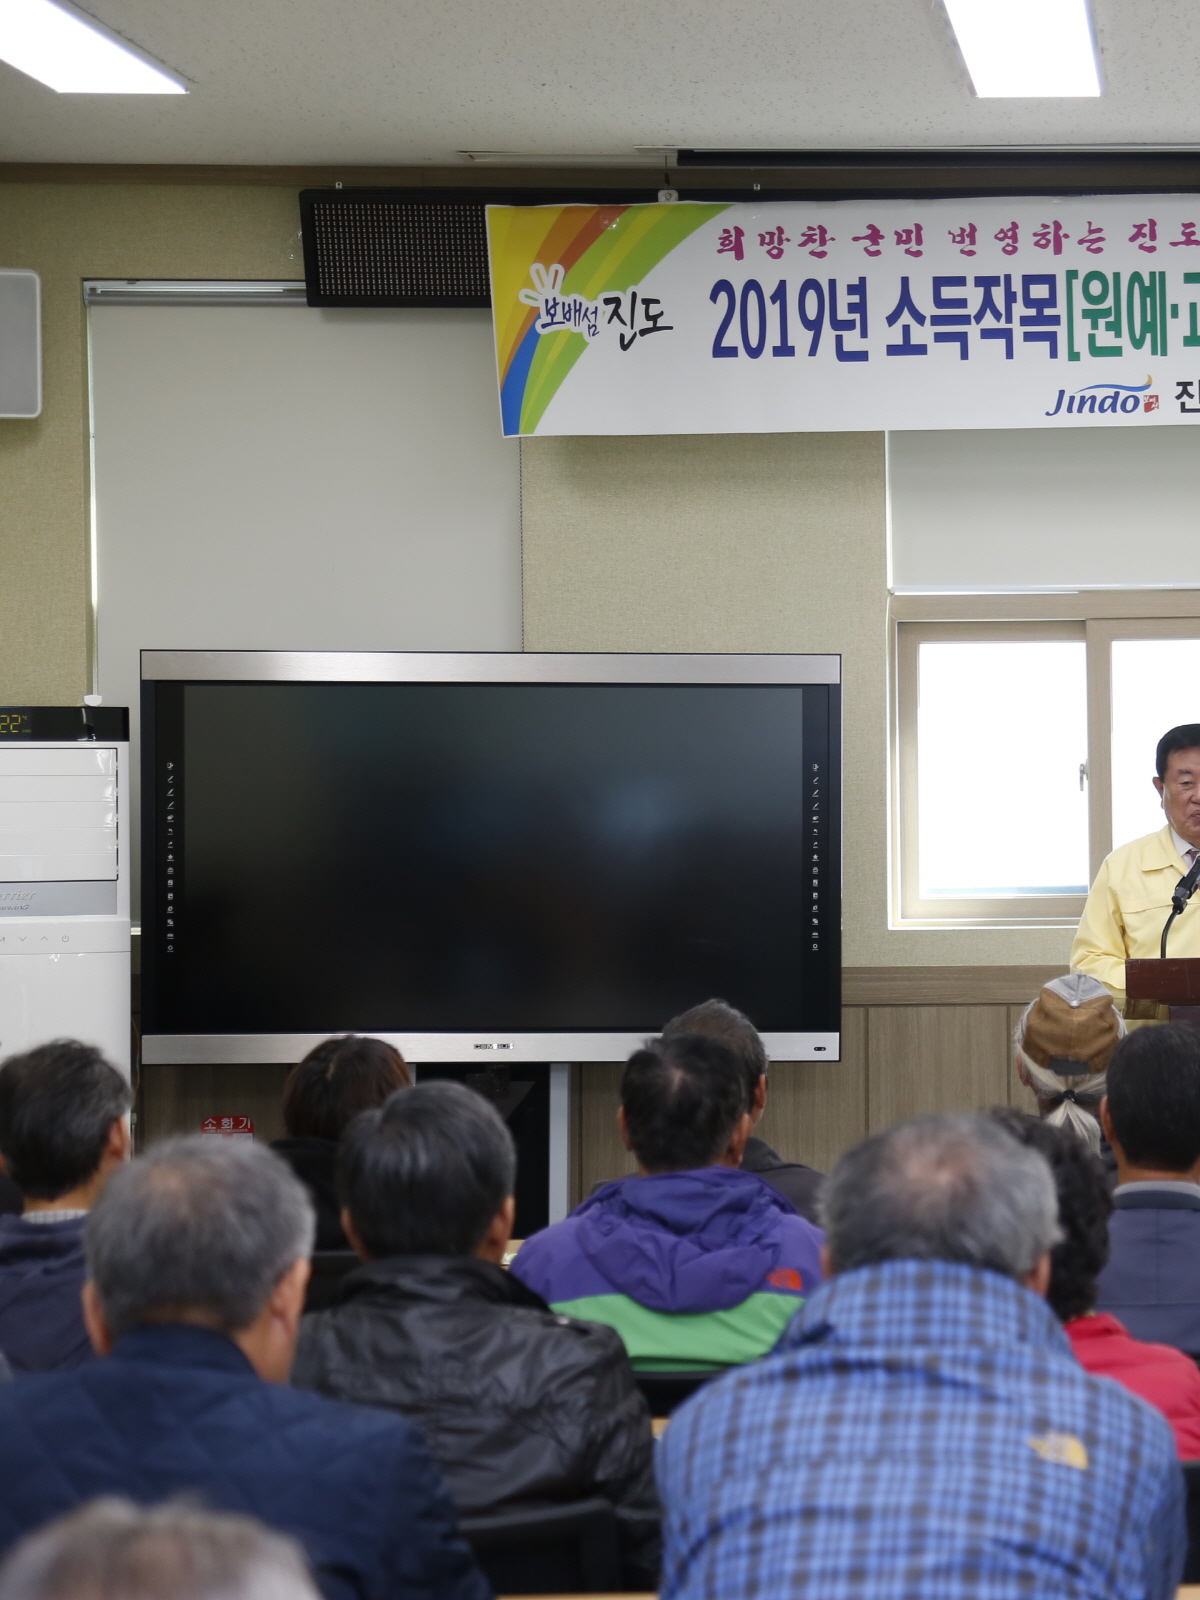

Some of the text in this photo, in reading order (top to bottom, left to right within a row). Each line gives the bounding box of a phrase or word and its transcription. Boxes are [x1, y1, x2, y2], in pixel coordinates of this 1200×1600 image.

[717, 224, 836, 261] 희망찬
[948, 219, 1106, 257] 번영하는
[541, 291, 674, 351] 보배섬 진도
[709, 276, 869, 362] 2019년
[1045, 389, 1141, 416] Jindo
[204, 1117, 251, 1130] 소화기
